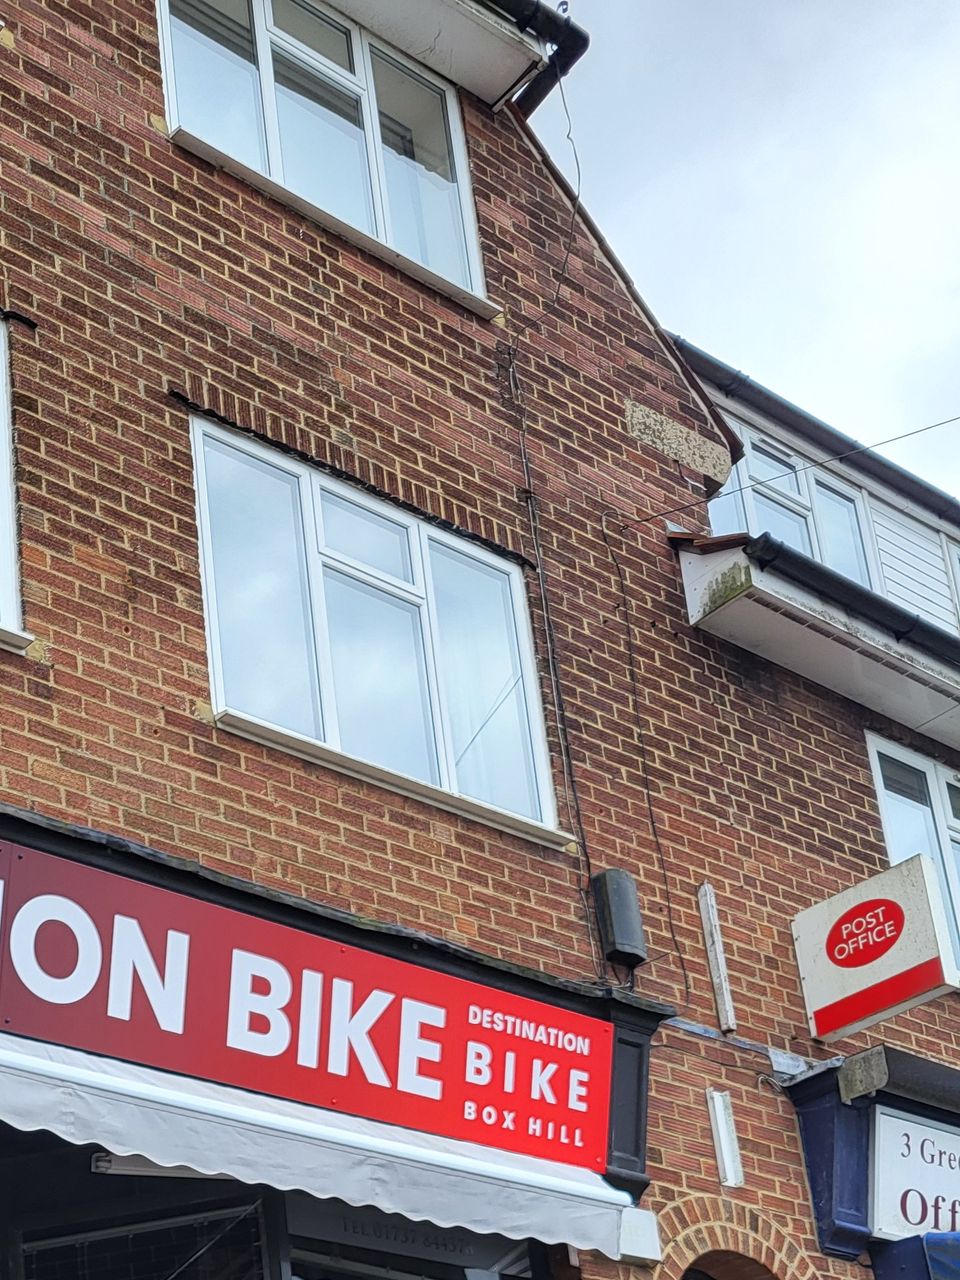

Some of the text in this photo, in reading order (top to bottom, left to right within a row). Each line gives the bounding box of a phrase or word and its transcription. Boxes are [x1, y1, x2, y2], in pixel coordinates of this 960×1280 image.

[834, 920, 897, 960] OFFICE
[841, 906, 886, 940] POST
[227, 947, 446, 1099] BIKE
[468, 1004, 590, 1056] DESTINATION
[465, 1040, 589, 1112] BIKE
[463, 1100, 584, 1147] BOX HILL
[900, 1132, 960, 1171] 3 Gre
